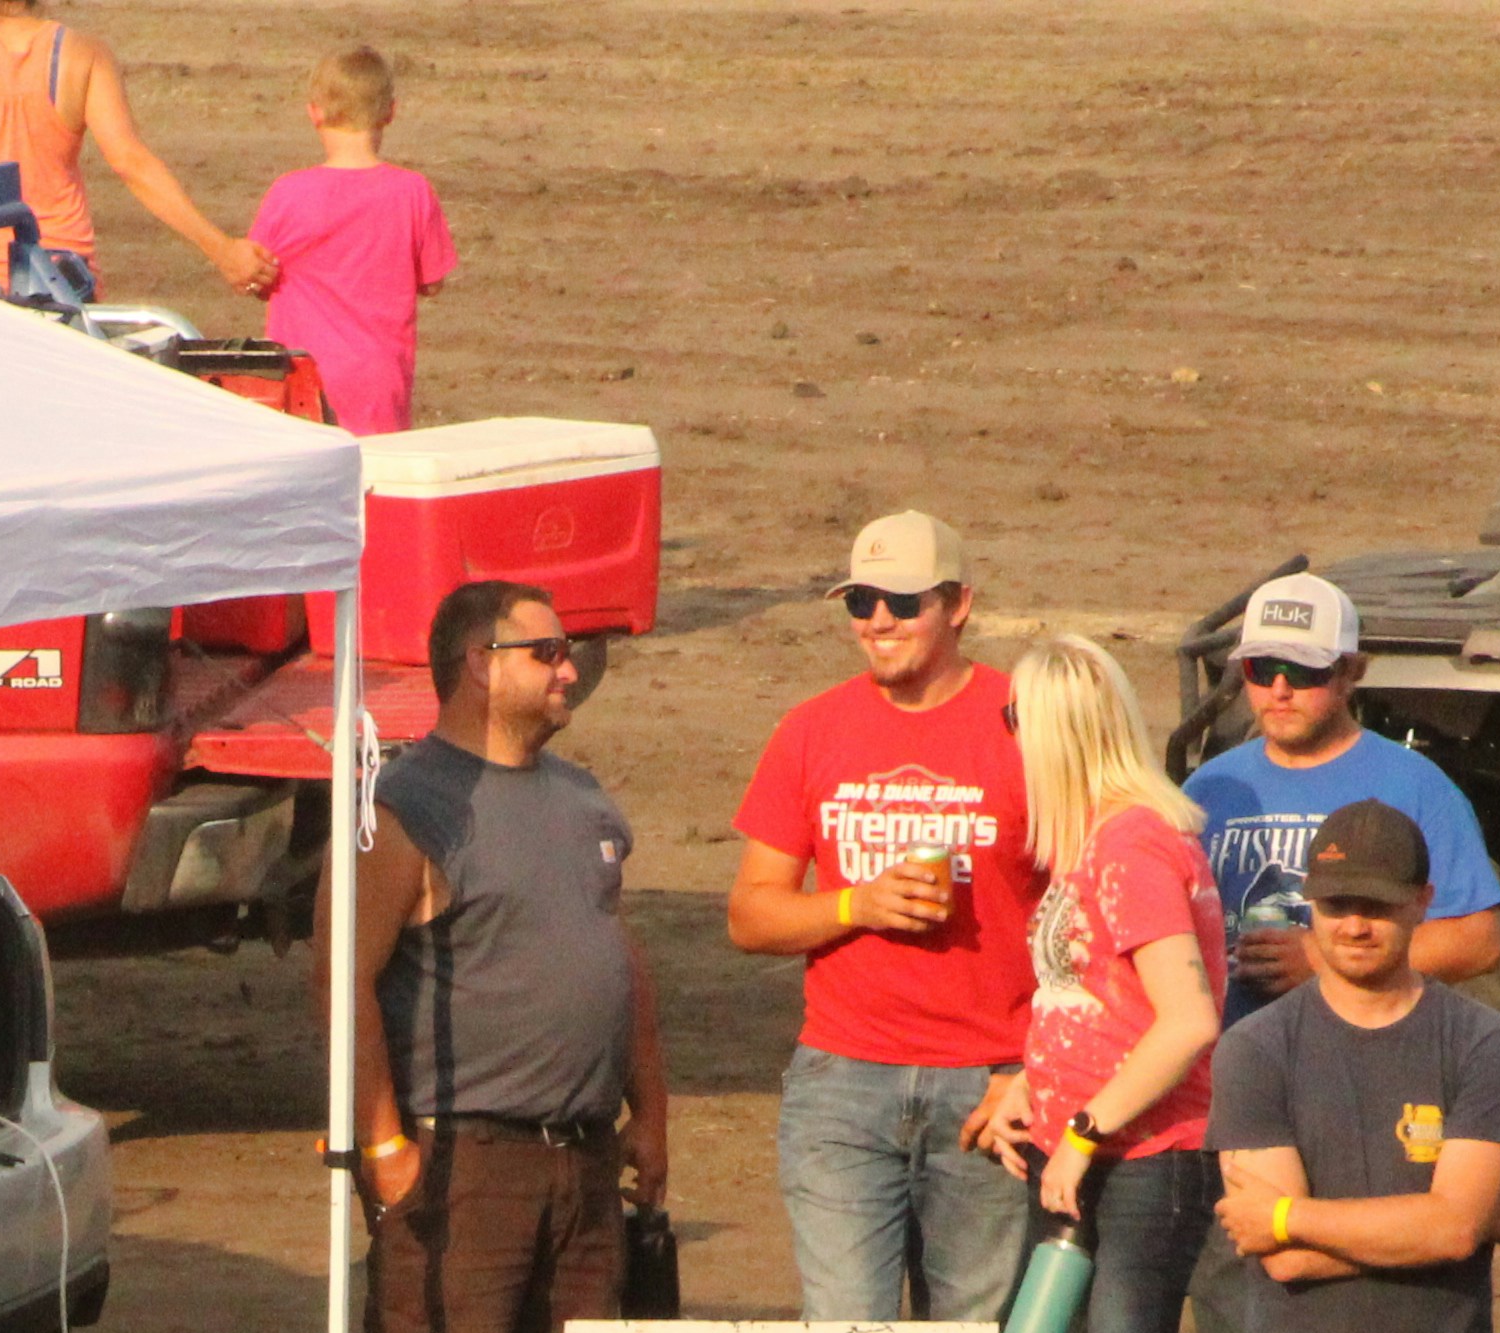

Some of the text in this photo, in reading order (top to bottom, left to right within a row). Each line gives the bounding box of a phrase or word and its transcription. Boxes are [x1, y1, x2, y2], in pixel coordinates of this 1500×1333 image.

[10, 677, 63, 689] ROAD
[834, 782, 984, 803] JIM & DIANE DUNN
[819, 801, 998, 847] Fireman's
[1217, 826, 1319, 882] FISHI
